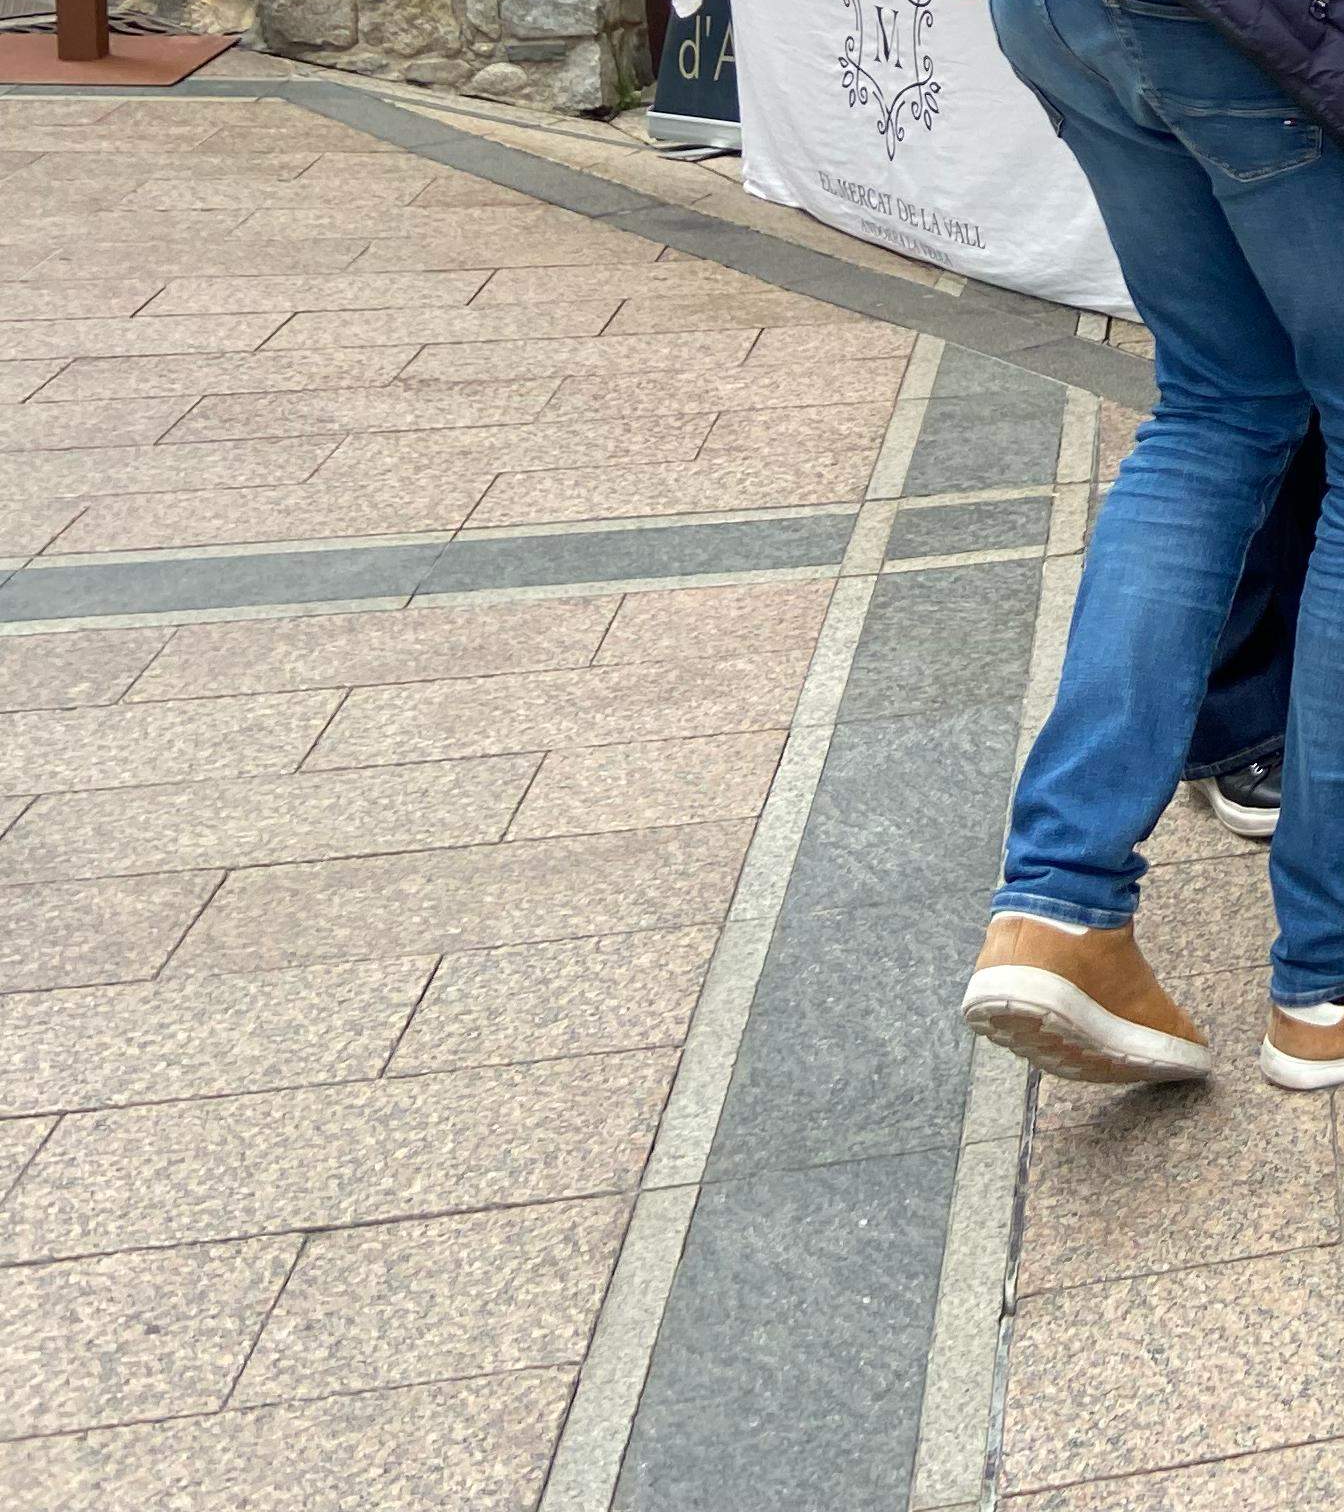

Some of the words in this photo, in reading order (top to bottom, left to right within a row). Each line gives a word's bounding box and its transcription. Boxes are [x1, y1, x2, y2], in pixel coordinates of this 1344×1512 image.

[838, 178, 893, 216] MERCAT
[897, 197, 919, 228] DE
[921, 207, 942, 237] LA
[943, 216, 987, 250] VALL
